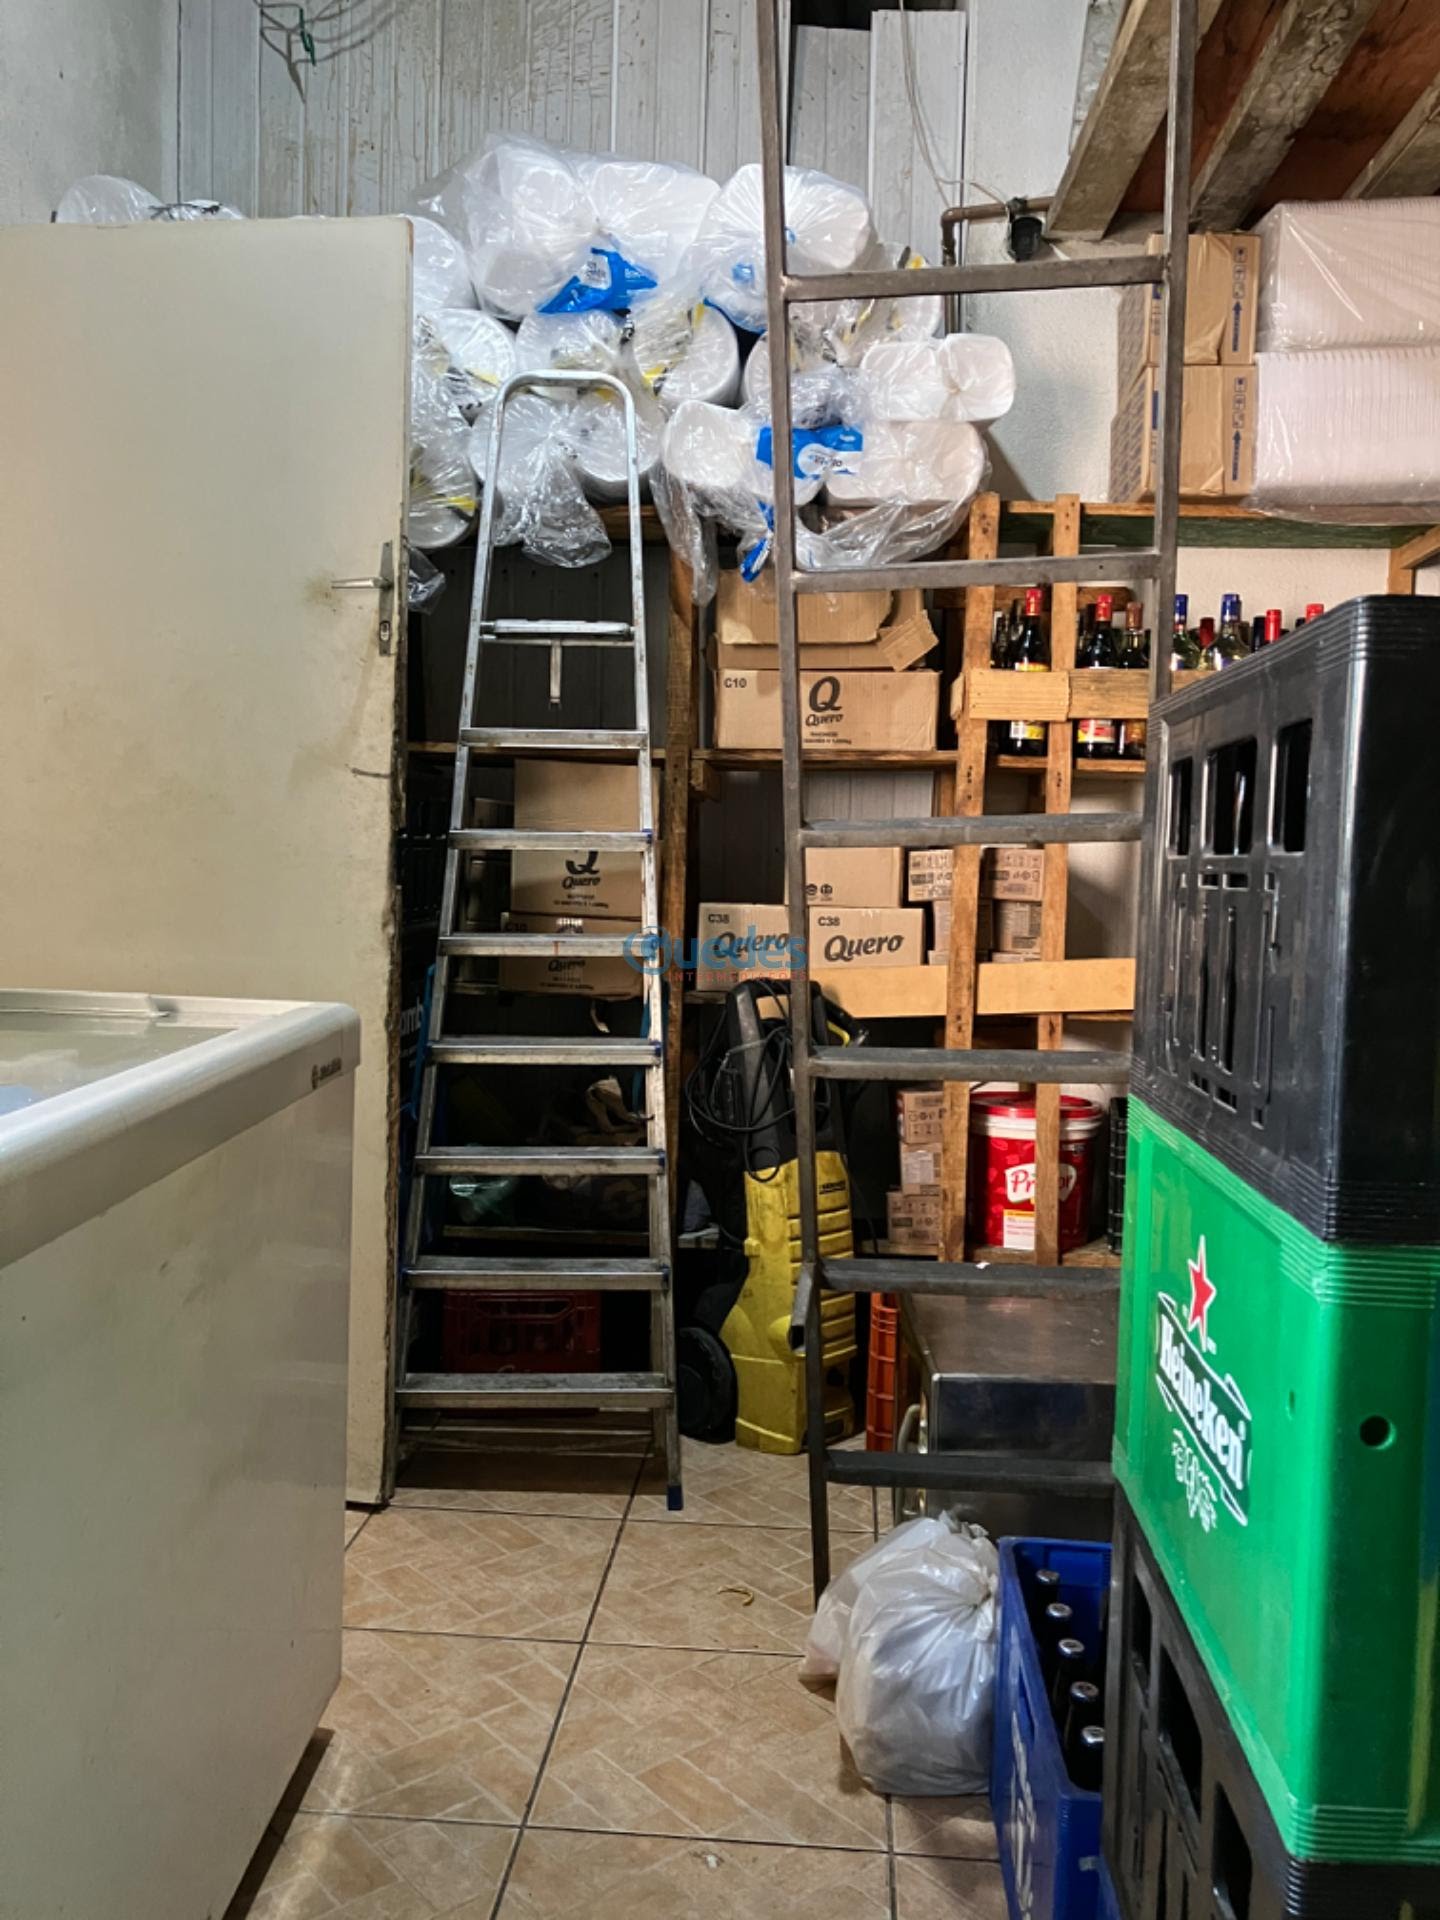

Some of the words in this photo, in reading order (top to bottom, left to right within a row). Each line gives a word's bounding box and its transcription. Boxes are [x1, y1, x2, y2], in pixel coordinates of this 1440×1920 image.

[723, 677, 748, 689] C10
[809, 675, 843, 713] Q
[805, 713, 844, 727] Quero
[562, 876, 601, 890] Quero
[708, 913, 730, 924] C38
[818, 916, 840, 927] C38
[824, 935, 905, 962] Quero
[1159, 1313, 1246, 1491] Heineken
